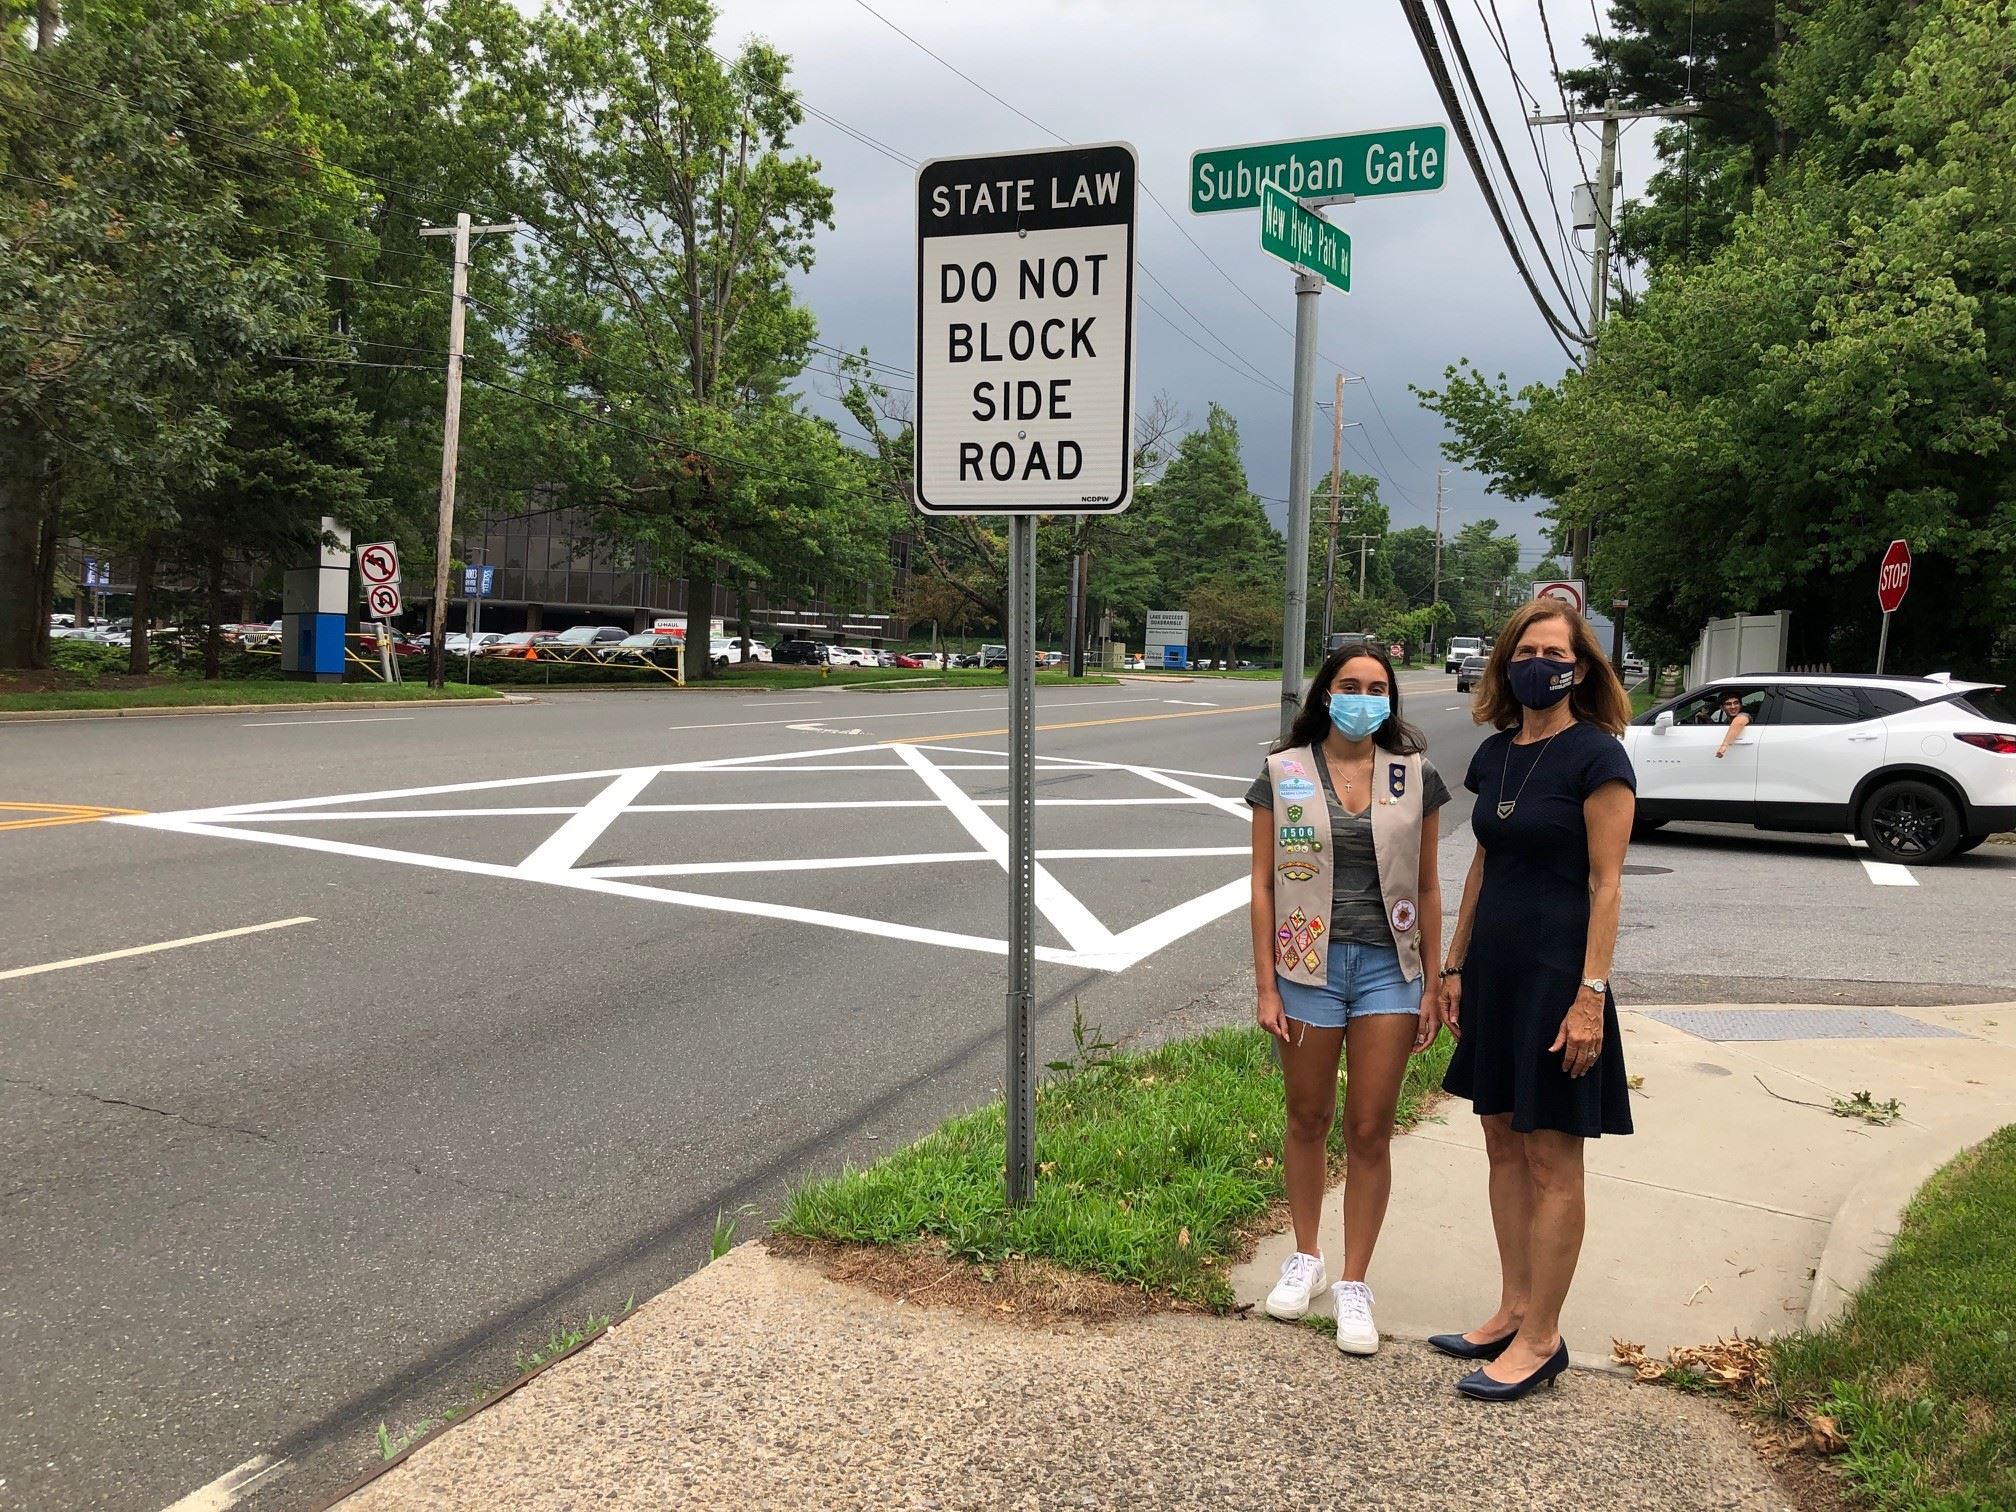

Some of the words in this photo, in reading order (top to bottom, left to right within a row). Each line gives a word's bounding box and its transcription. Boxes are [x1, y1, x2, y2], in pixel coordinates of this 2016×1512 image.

[932, 179, 1035, 218] STATE
[1051, 170, 1121, 209] LAW
[1198, 154, 1344, 202] Suburban
[1365, 140, 1438, 186] Gate
[1266, 191, 1285, 241] New
[1291, 206, 1313, 262] Hyde
[1319, 223, 1337, 271] Park
[1341, 247, 1349, 277] Rd
[941, 261, 997, 304] DO
[1019, 254, 1108, 300] NOT
[948, 316, 1097, 363] BLOCK
[972, 379, 1072, 422] SIDE
[959, 440, 1083, 482] ROAD
[1881, 562, 1908, 591] STOP
[1282, 826, 1314, 838] 1506
